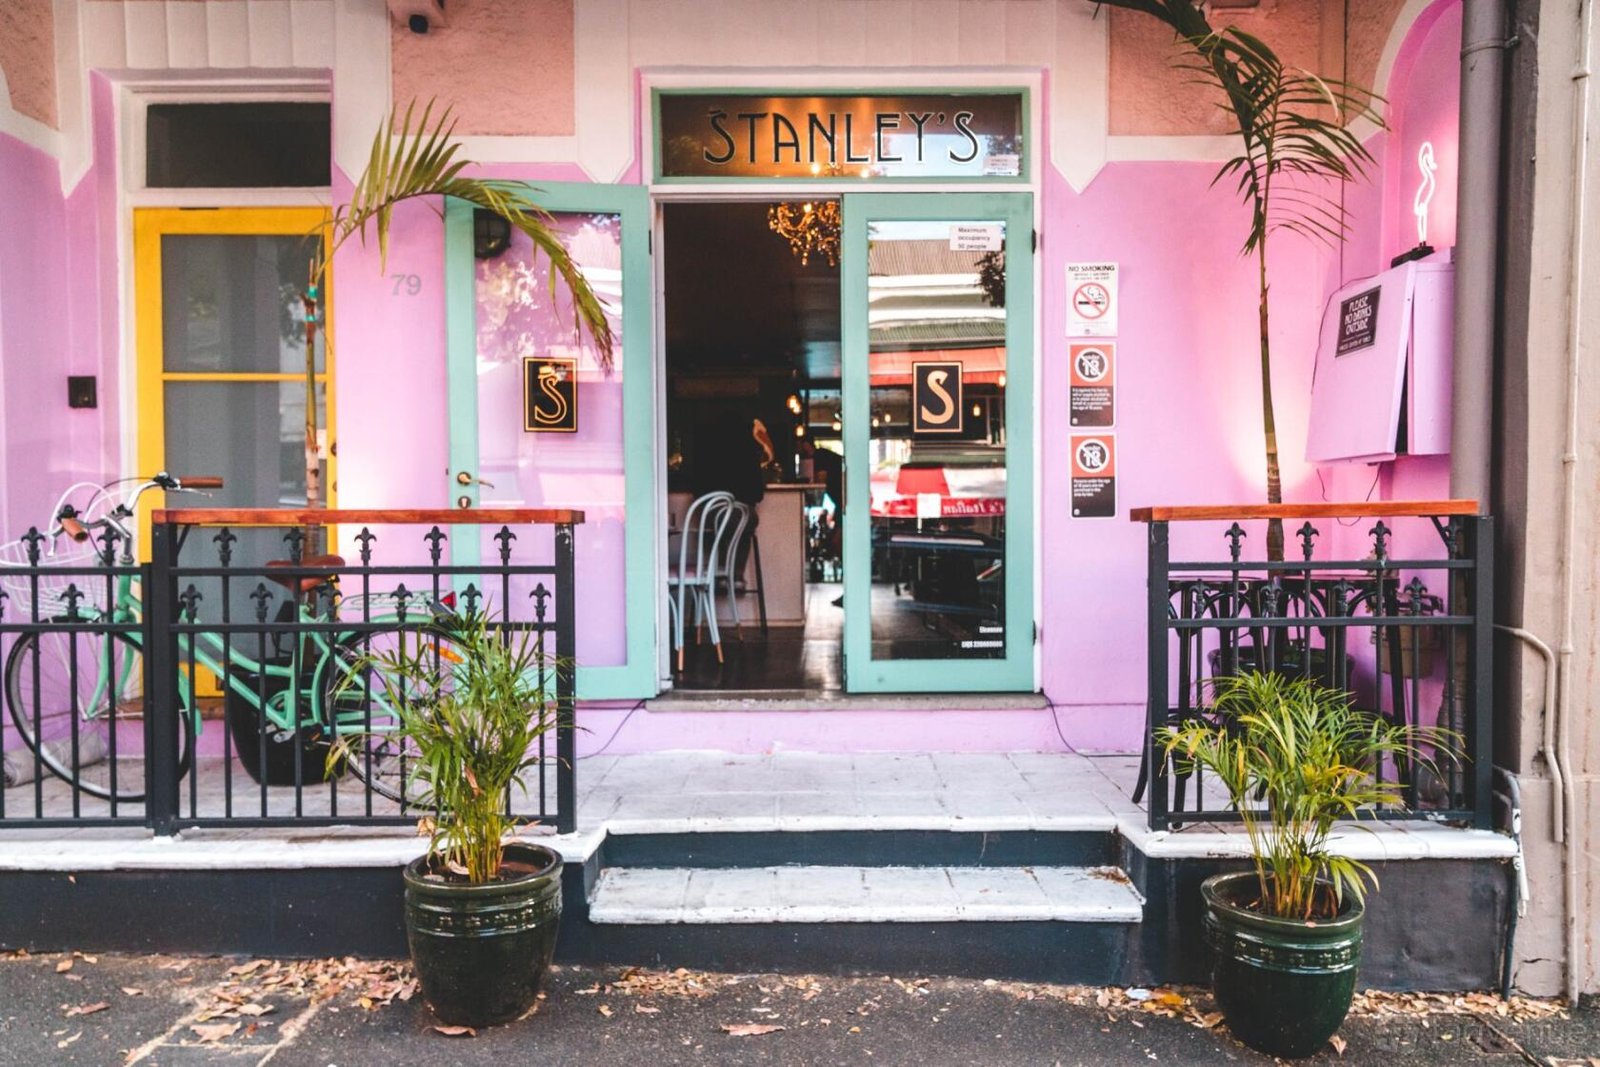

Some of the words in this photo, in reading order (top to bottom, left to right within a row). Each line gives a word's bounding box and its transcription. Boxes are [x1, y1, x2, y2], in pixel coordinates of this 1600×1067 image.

[703, 110, 981, 164] STANLEY'S
[390, 273, 422, 296] 79
[1349, 296, 1368, 312] PLEASE
[1345, 313, 1353, 325] NO
[1353, 305, 1372, 321] DRINKS
[1346, 318, 1368, 335] OUTSIDE
[1082, 360, 1100, 376] 18
[534, 374, 567, 424] S
[921, 370, 955, 424] S
[1083, 451, 1101, 467] 18
